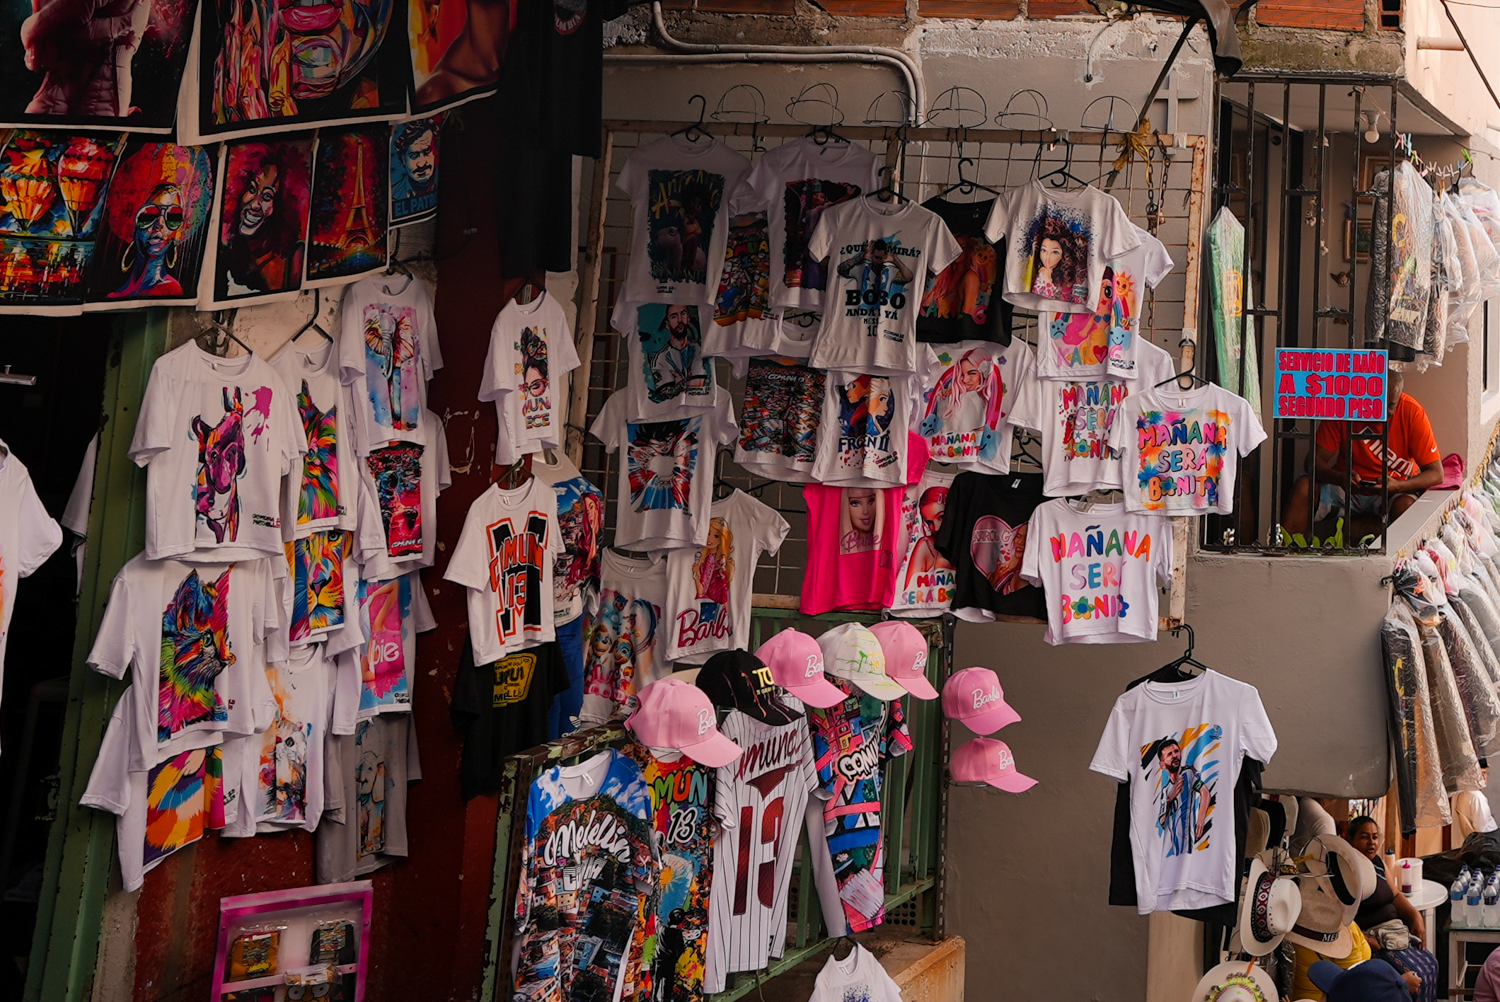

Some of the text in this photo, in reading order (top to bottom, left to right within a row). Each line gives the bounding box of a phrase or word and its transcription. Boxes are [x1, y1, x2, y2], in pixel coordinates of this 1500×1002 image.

[394, 201, 408, 217] EL
[845, 289, 906, 310] BOBO
[1278, 351, 1385, 374] SERVICIO DE BAÑO
[1278, 373, 1383, 397] A $1000
[1278, 395, 1382, 419] SEGUNDO PISO
[931, 432, 976, 447] MAÑANA
[1138, 418, 1227, 449] MAÑANA
[1157, 447, 1208, 474] SERÁ
[1049, 525, 1151, 563] MAÑANA
[508, 571, 527, 608] 13
[901, 588, 935, 606] SERÁ
[666, 807, 699, 846] 13
